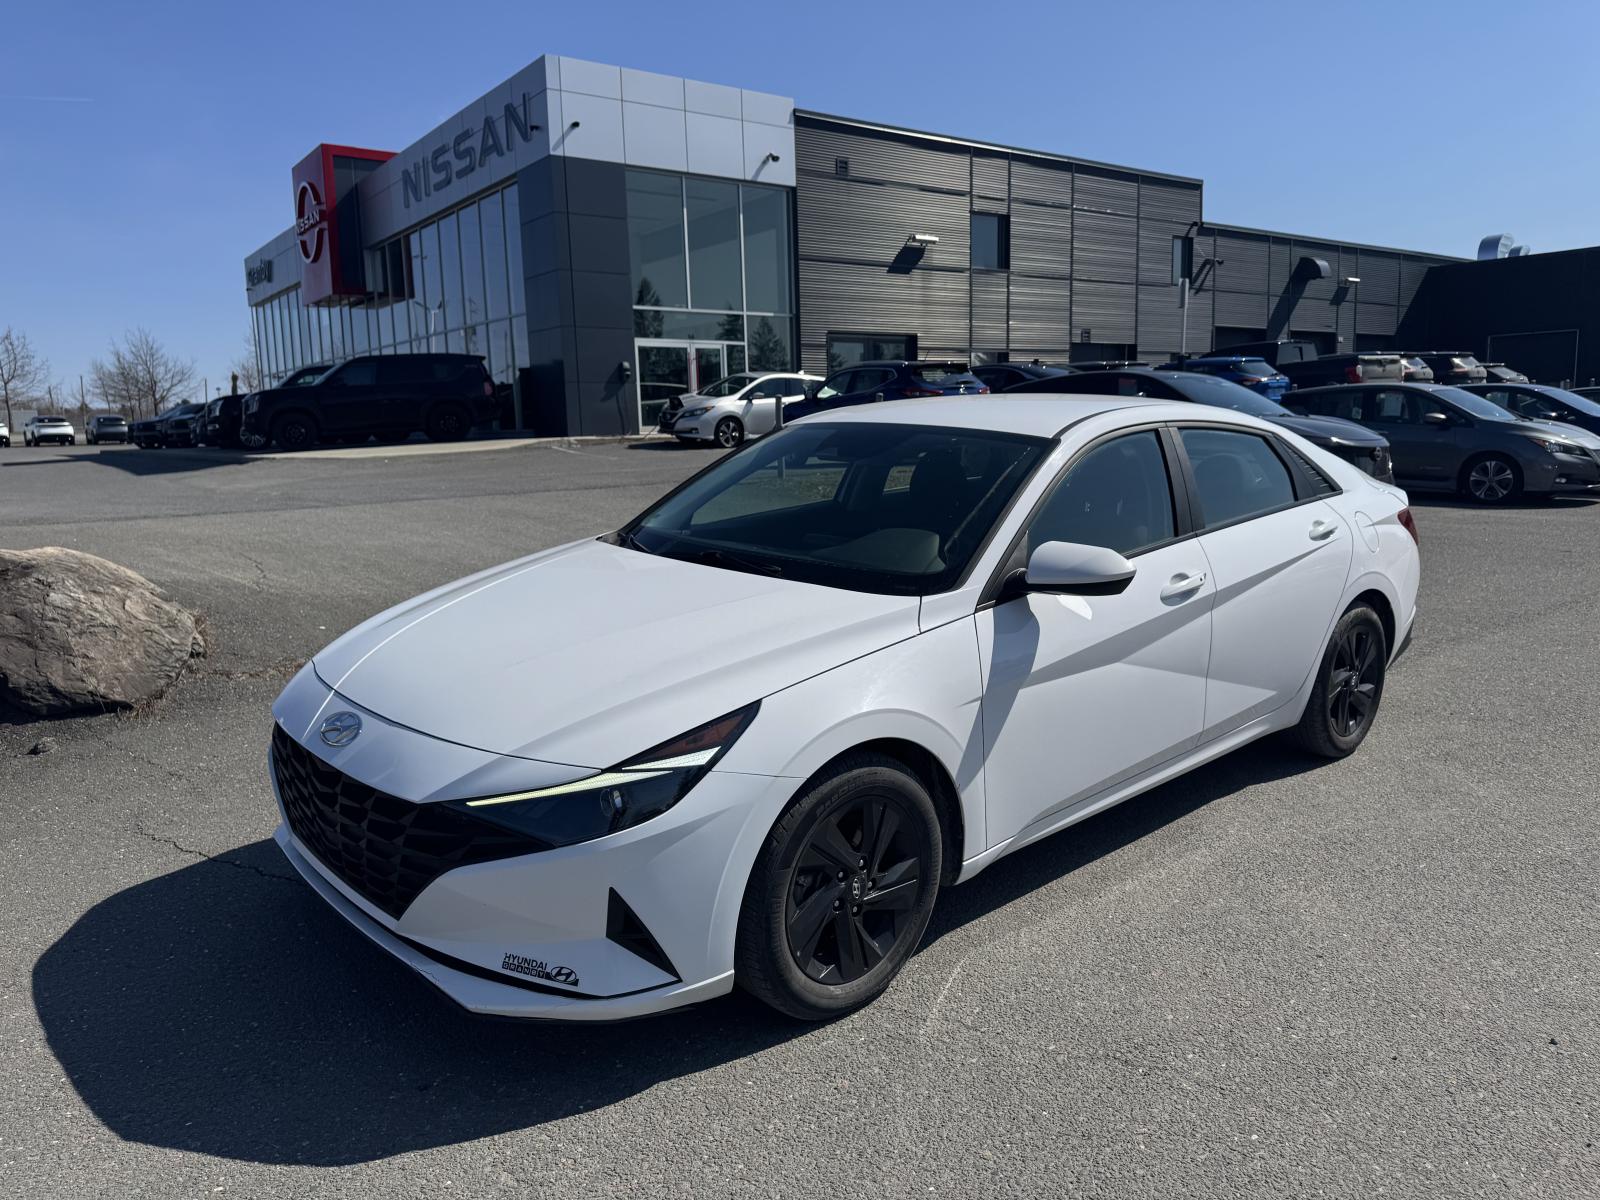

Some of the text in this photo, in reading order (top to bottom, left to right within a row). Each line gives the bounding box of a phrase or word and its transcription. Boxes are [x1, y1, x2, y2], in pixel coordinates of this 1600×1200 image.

[401, 91, 532, 209] NISSAN
[502, 961, 546, 979] GRANBY
[503, 952, 548, 971] HYUNDAI
